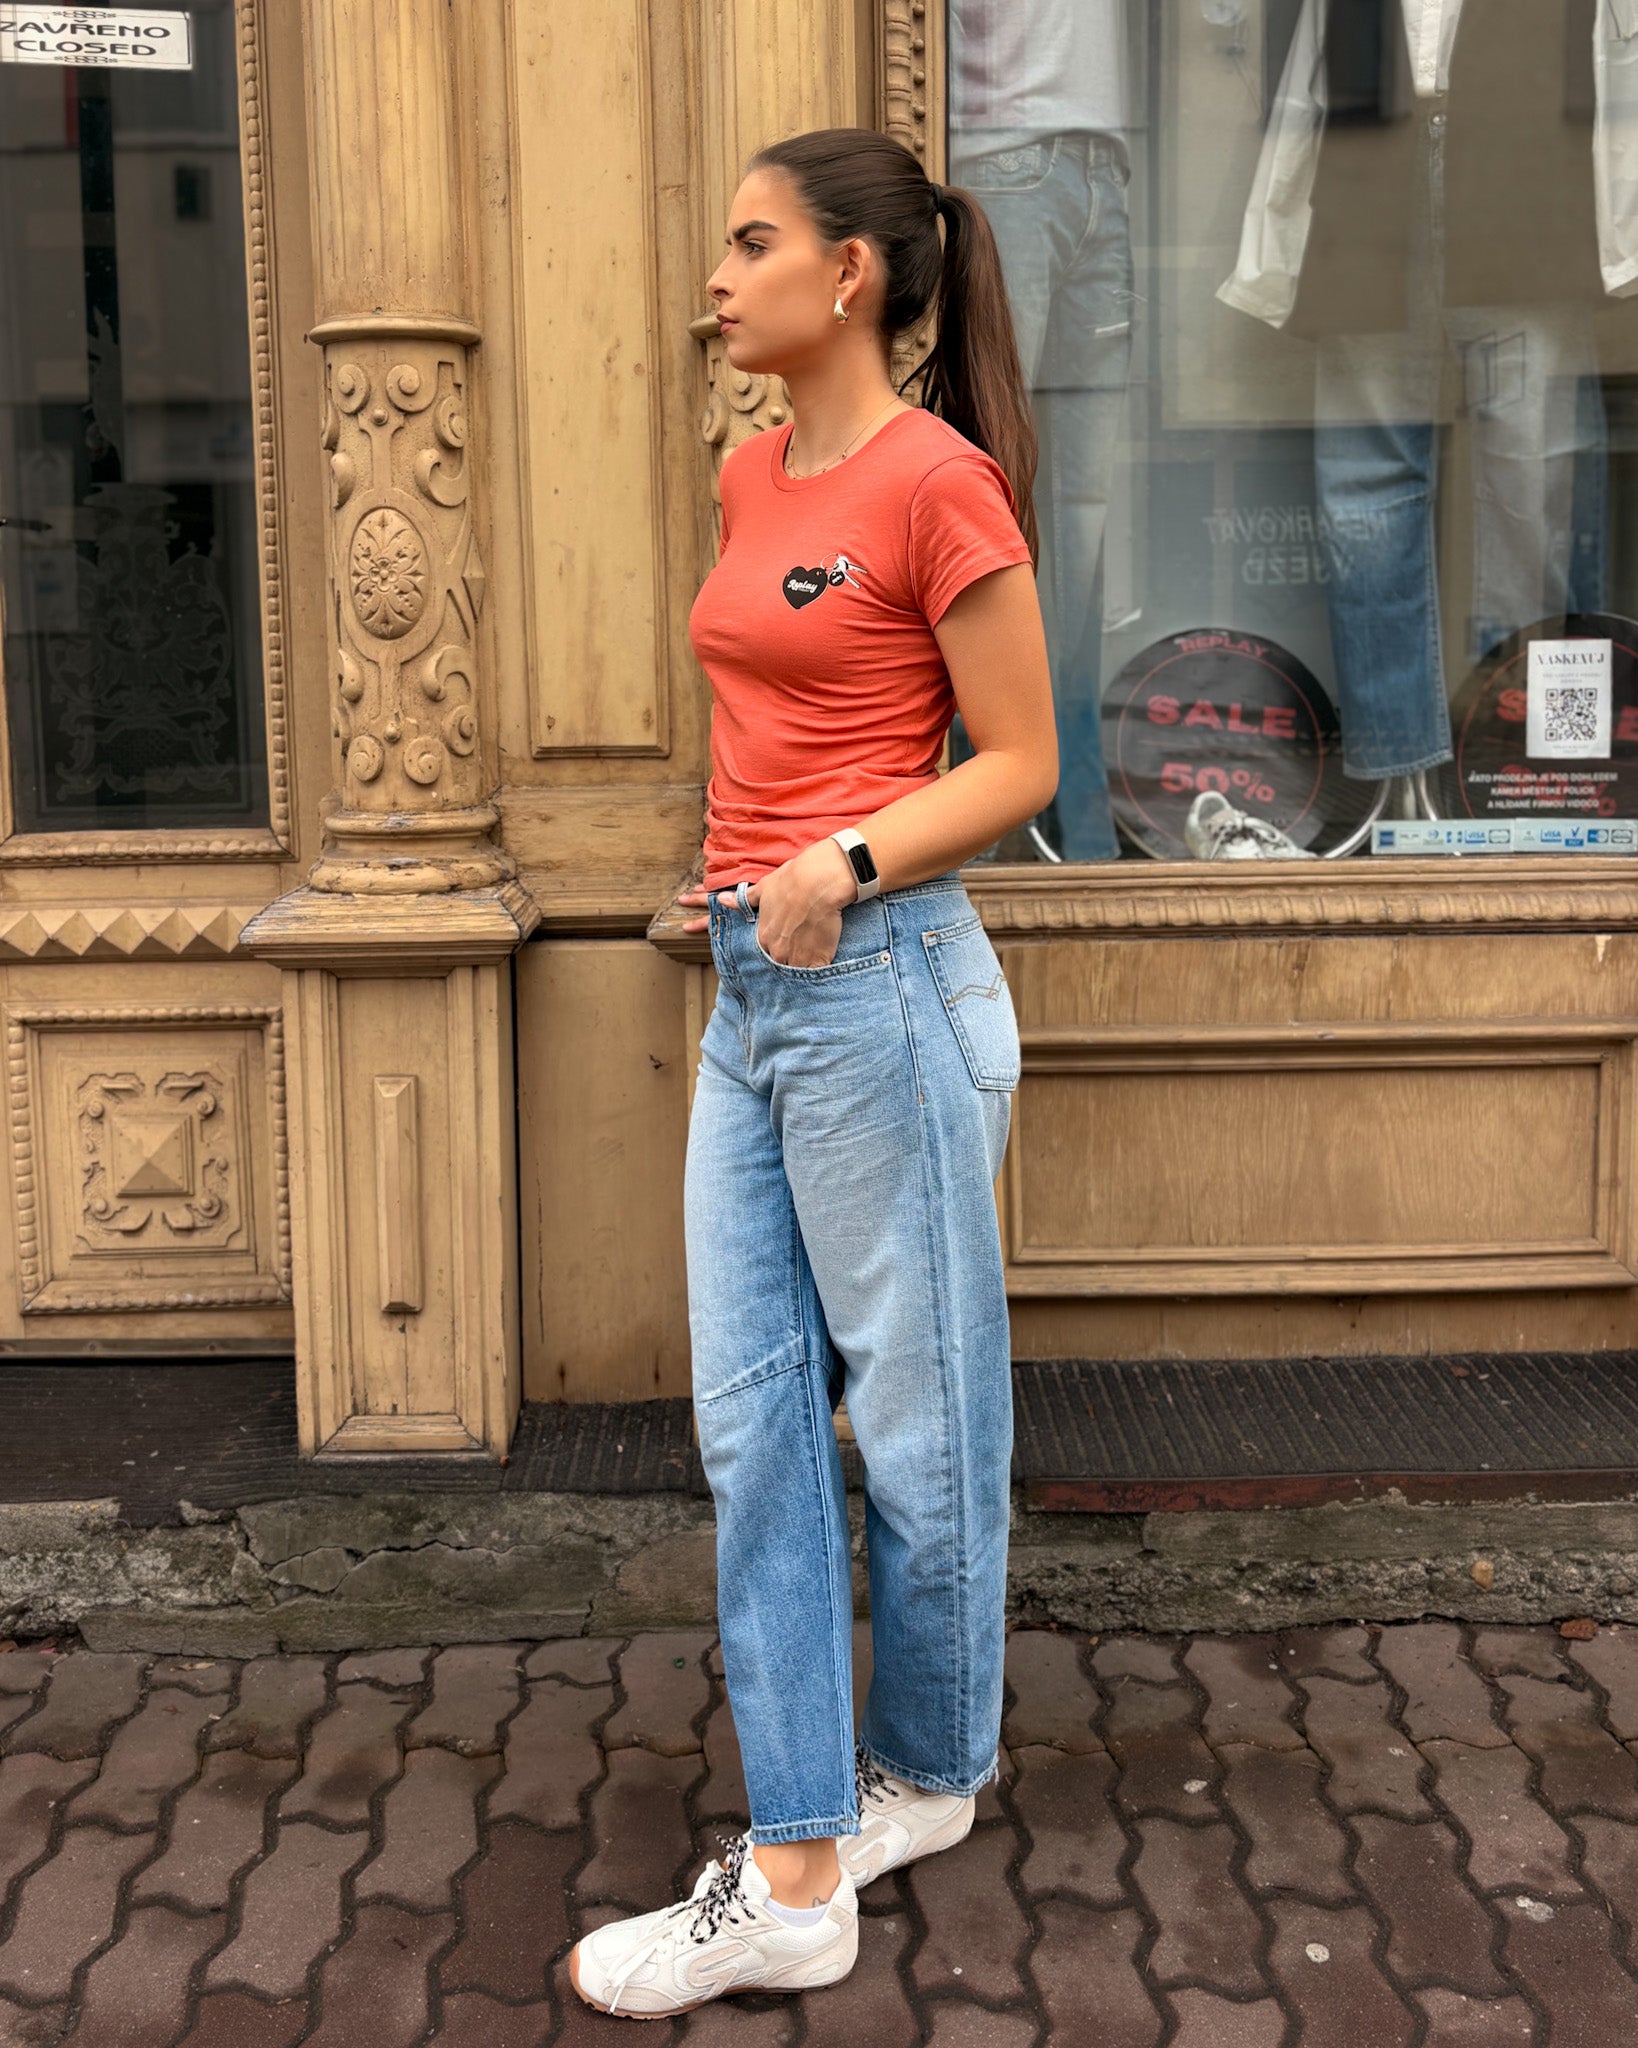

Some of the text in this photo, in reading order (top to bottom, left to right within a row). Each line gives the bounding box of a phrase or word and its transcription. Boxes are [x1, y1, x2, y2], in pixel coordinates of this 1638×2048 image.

[0, 20, 171, 39] ZAVŘENO
[13, 40, 157, 56] CLOSED
[1180, 635, 1267, 657] REPLAY
[1146, 694, 1298, 740] SALE
[1160, 761, 1276, 803] 50%
[1467, 831, 1486, 839] VISA
[1543, 830, 1562, 838] VISA
